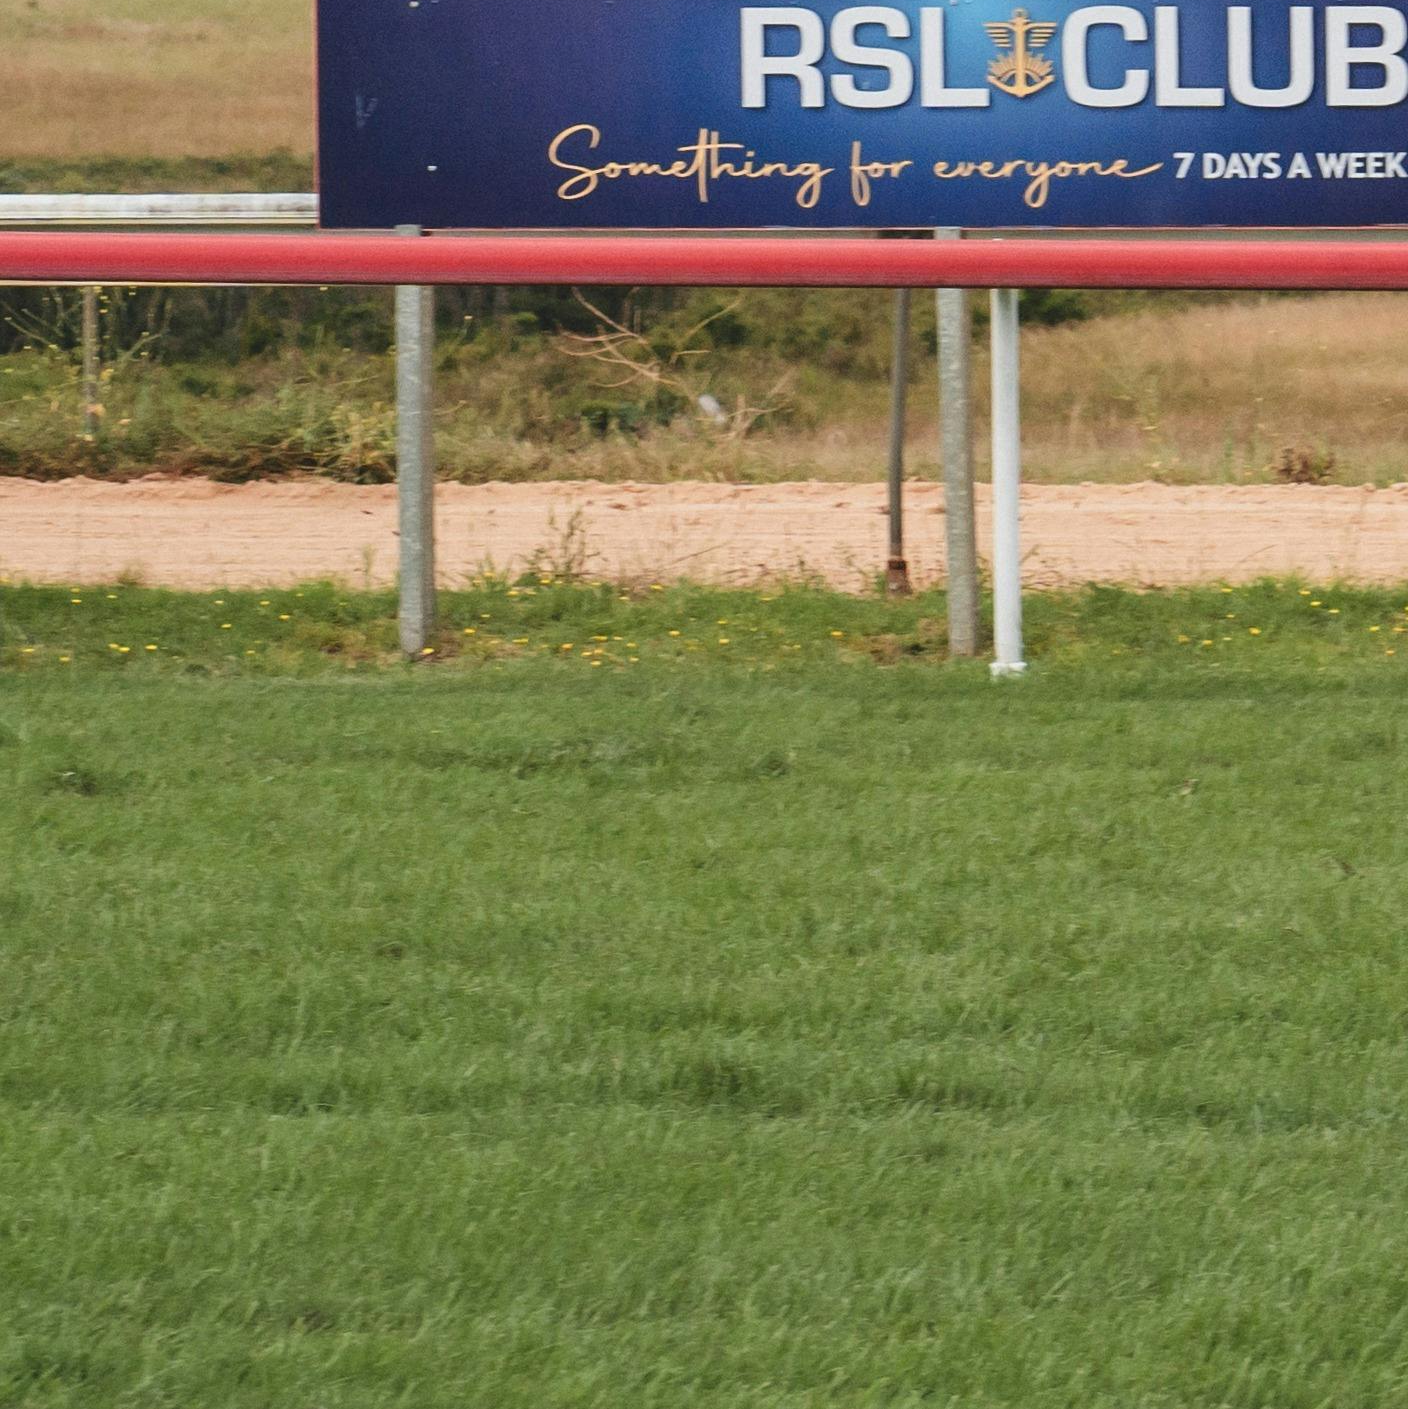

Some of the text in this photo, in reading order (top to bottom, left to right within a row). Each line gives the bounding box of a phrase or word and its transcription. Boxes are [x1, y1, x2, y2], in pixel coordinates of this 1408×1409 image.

[741, 6, 990, 108] RSL
[548, 124, 1408, 208] Something for everyone 7 DAYS A WEEK
